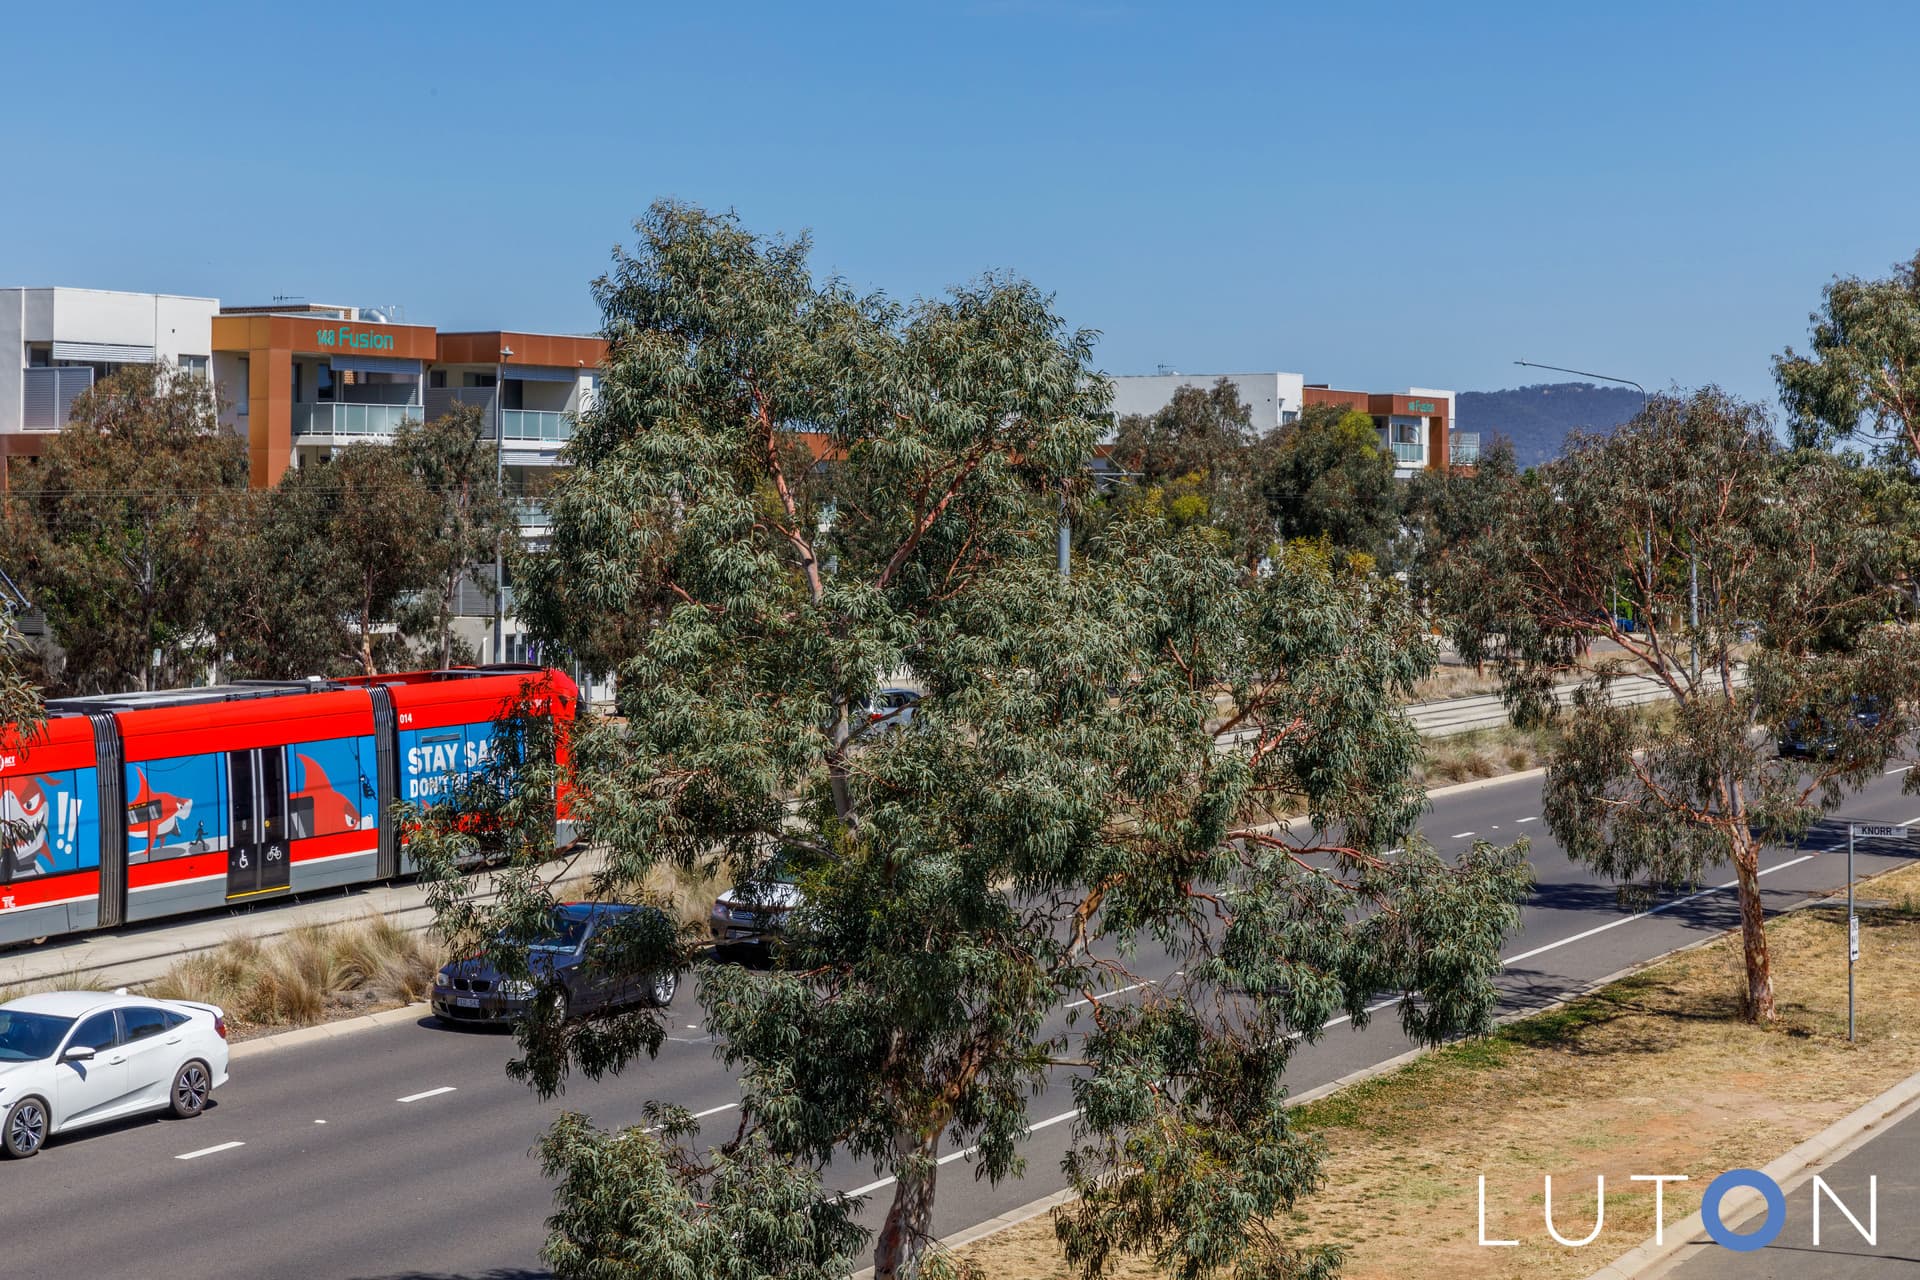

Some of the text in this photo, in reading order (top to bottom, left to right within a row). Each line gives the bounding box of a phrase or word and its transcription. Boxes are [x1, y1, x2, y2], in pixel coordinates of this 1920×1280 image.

[316, 326, 394, 350] 148 Fusion
[400, 713, 412, 724] 014
[408, 743, 458, 775] STAY
[1861, 826, 1893, 836] KNORR
